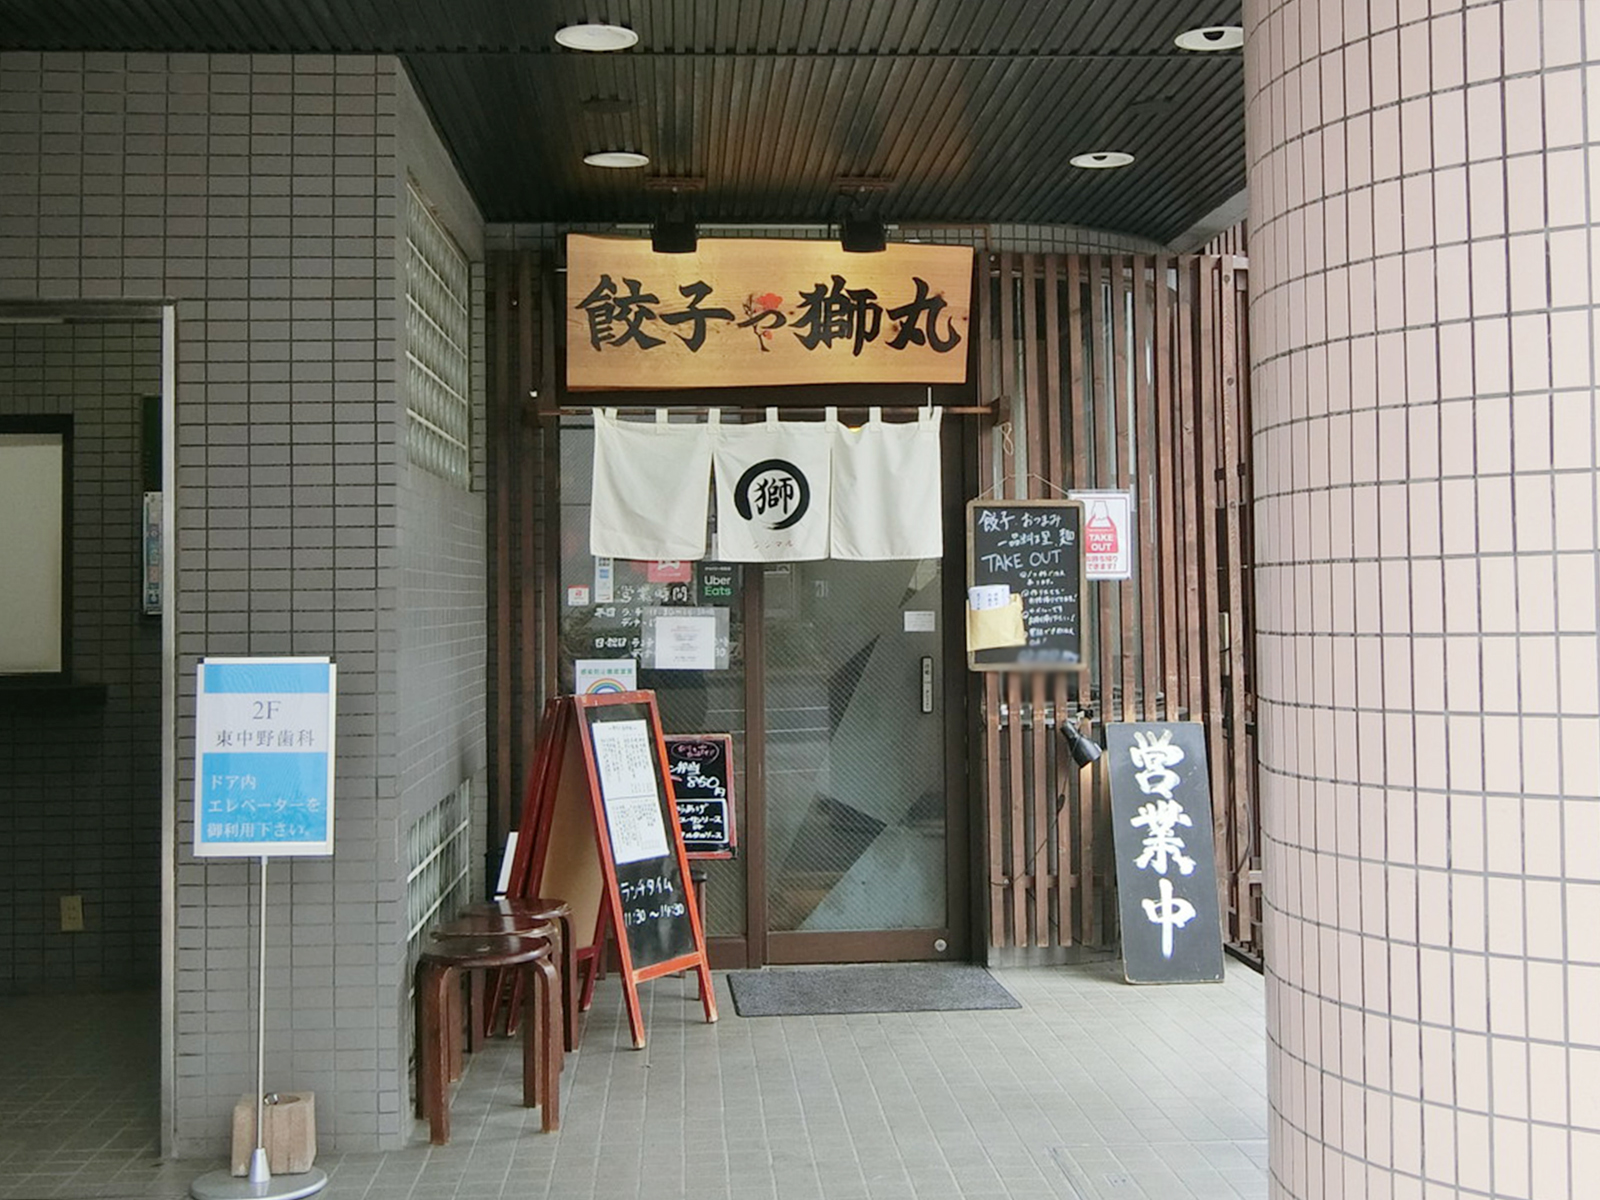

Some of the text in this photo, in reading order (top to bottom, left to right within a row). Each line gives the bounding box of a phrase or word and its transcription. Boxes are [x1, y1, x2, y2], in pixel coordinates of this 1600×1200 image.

[1089, 533, 1114, 542] TAKE
[1091, 542, 1112, 552] OUT
[980, 552, 1024, 574] TAKE
[1029, 548, 1062, 568] OUT
[703, 575, 731, 586] Uber
[618, 585, 689, 603] 営業時間
[703, 586, 732, 596] Eats
[252, 700, 282, 720] 2F
[215, 729, 316, 748] 東中野歯科
[210, 774, 257, 791] ドア内
[207, 797, 321, 813] エレベーターを
[206, 822, 312, 839] 御利用下さい。
[1129, 728, 1197, 960] 営業中
[620, 875, 674, 903] ランチタイム
